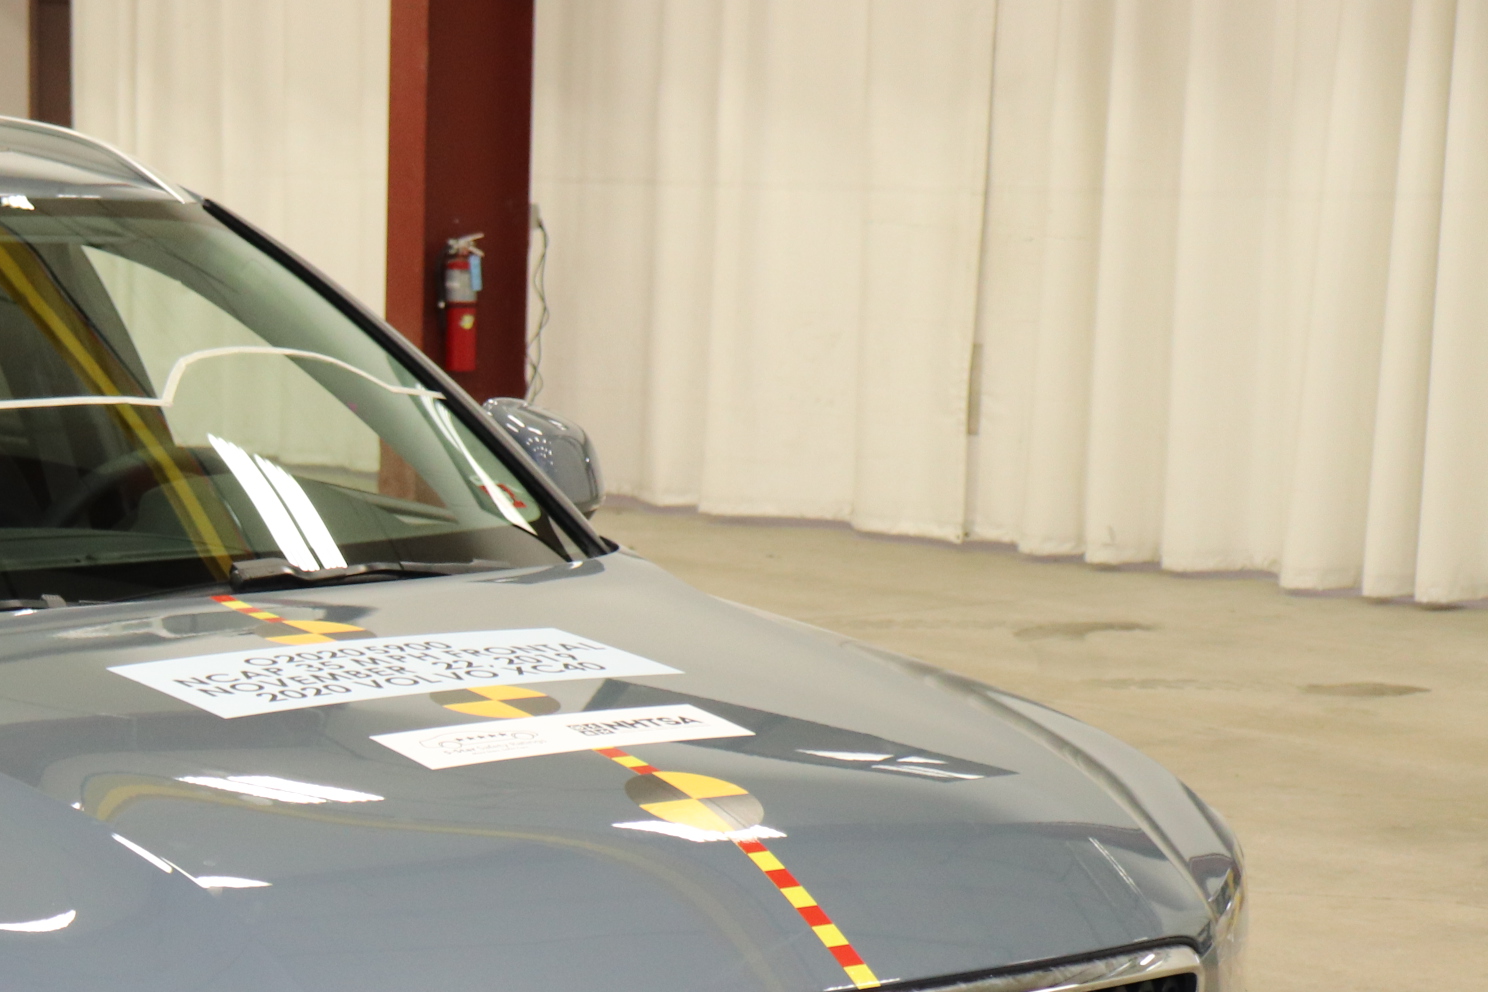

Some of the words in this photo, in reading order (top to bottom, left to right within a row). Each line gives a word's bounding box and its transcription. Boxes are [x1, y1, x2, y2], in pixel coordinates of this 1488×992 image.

[173, 667, 286, 688] NCAP
[295, 660, 345, 673] 35
[351, 652, 440, 668] MPH
[443, 641, 606, 659] FRONTAL
[196, 665, 416, 697] NOVEMBER
[493, 652, 579, 666] 2019
[256, 683, 352, 703] 2020
[353, 669, 499, 690] VOLVO
[500, 661, 607, 676] XC40
[601, 715, 703, 732] NHTSA
